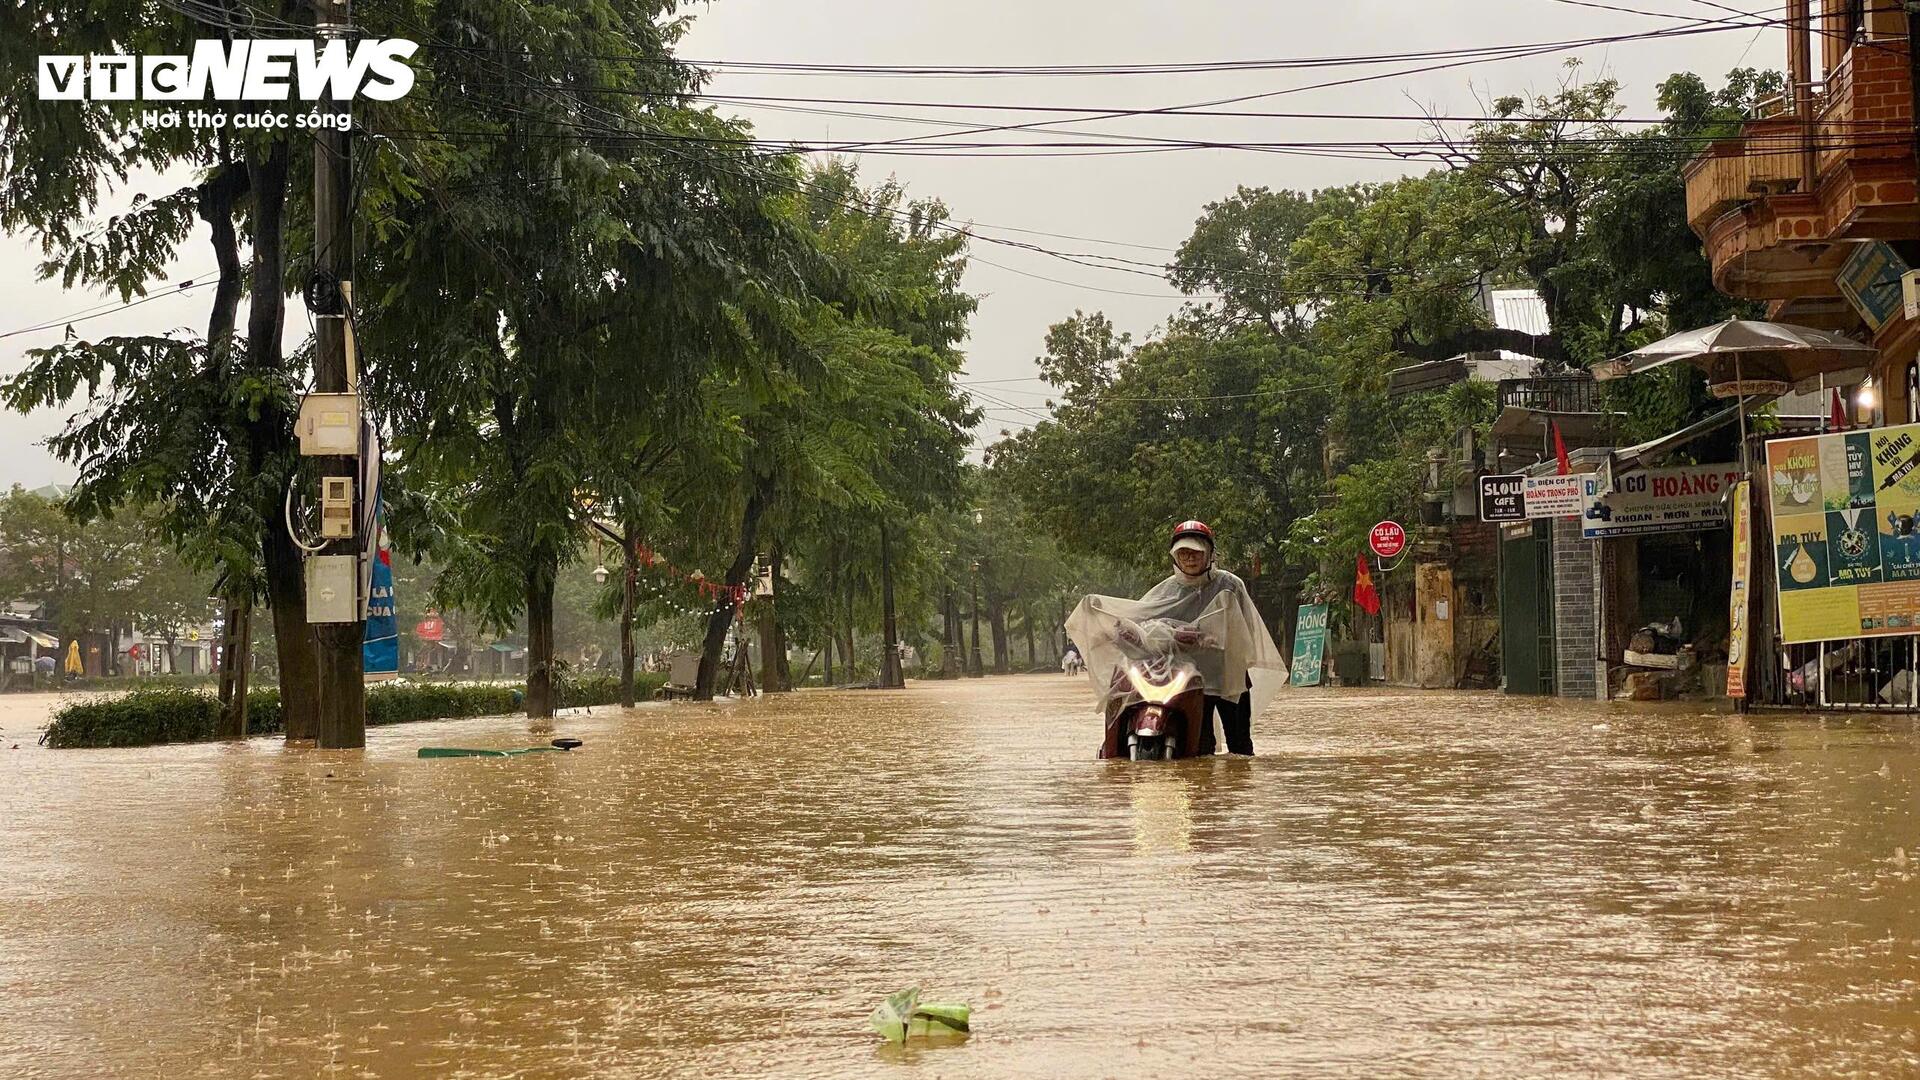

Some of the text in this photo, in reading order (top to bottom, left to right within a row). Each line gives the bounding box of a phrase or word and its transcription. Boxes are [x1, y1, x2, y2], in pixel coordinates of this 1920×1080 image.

[1875, 433, 1913, 466] KHÔNG
[1849, 462, 1861, 470] HIV
[1892, 470, 1904, 482] MA
[1484, 482, 1523, 496] SLOW
[1626, 474, 1647, 493] CƠ
[1652, 471, 1720, 497] HOÀNG
[1615, 513, 1653, 523] KHOAN
